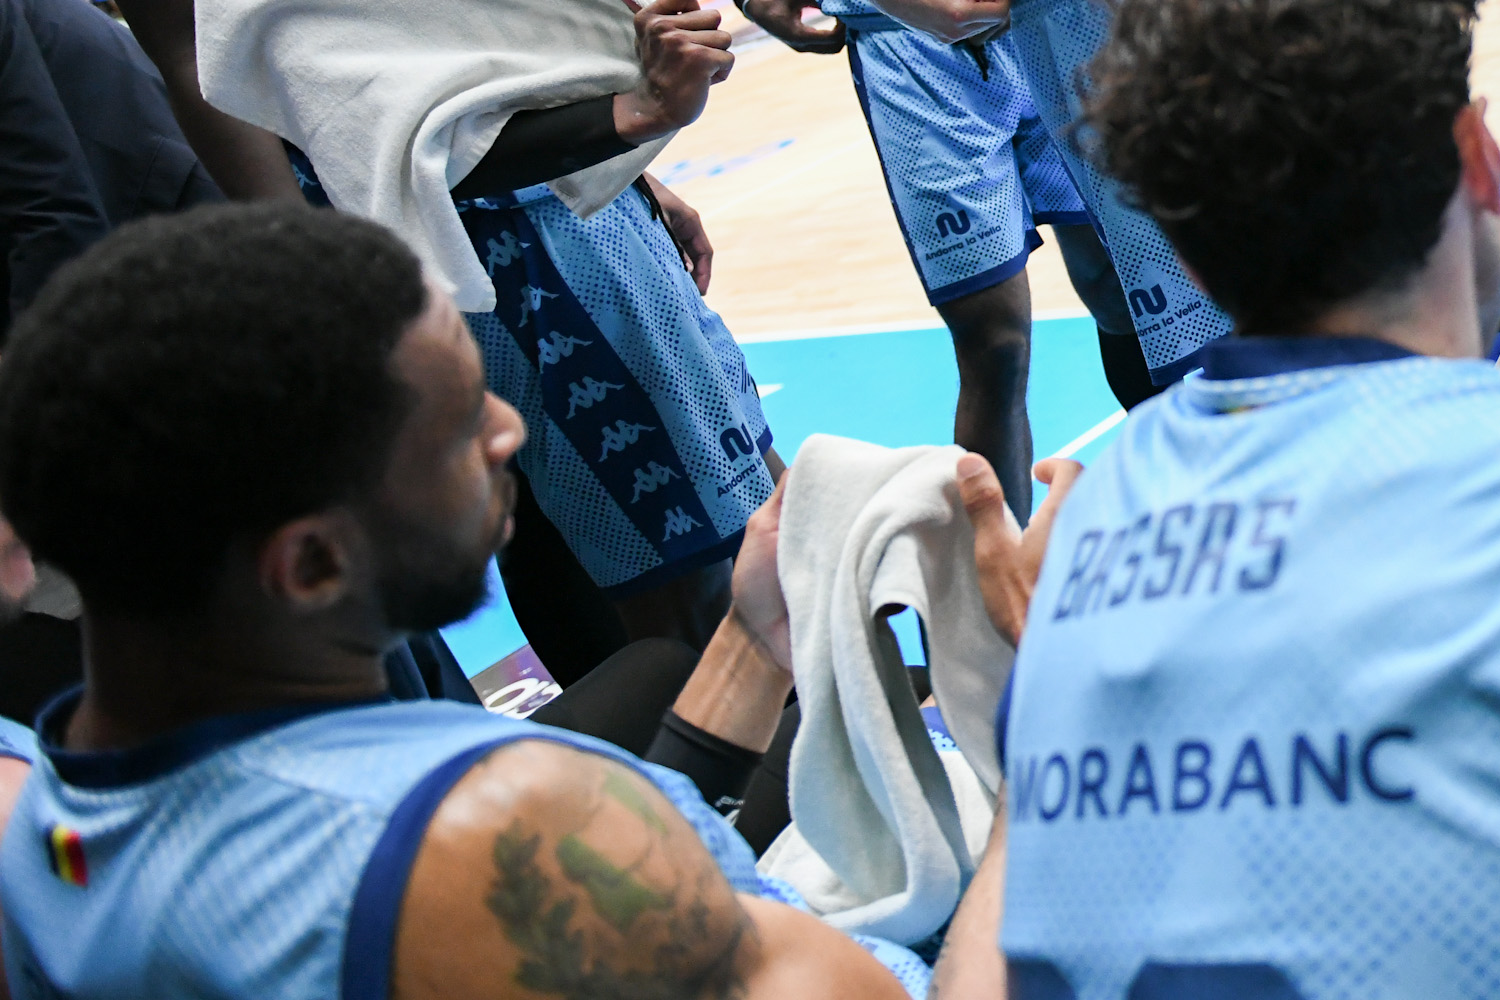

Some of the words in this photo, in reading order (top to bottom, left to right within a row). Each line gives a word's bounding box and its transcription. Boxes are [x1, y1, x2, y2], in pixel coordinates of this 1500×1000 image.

[926, 242, 964, 260] Andorra
[965, 237, 977, 246] la
[977, 225, 1002, 240] Vella
[1140, 323, 1161, 337] orra
[1161, 316, 1175, 327] la
[1174, 300, 1202, 319] Vella
[717, 463, 757, 498] Andorra
[1011, 725, 1417, 825] MORABANC
